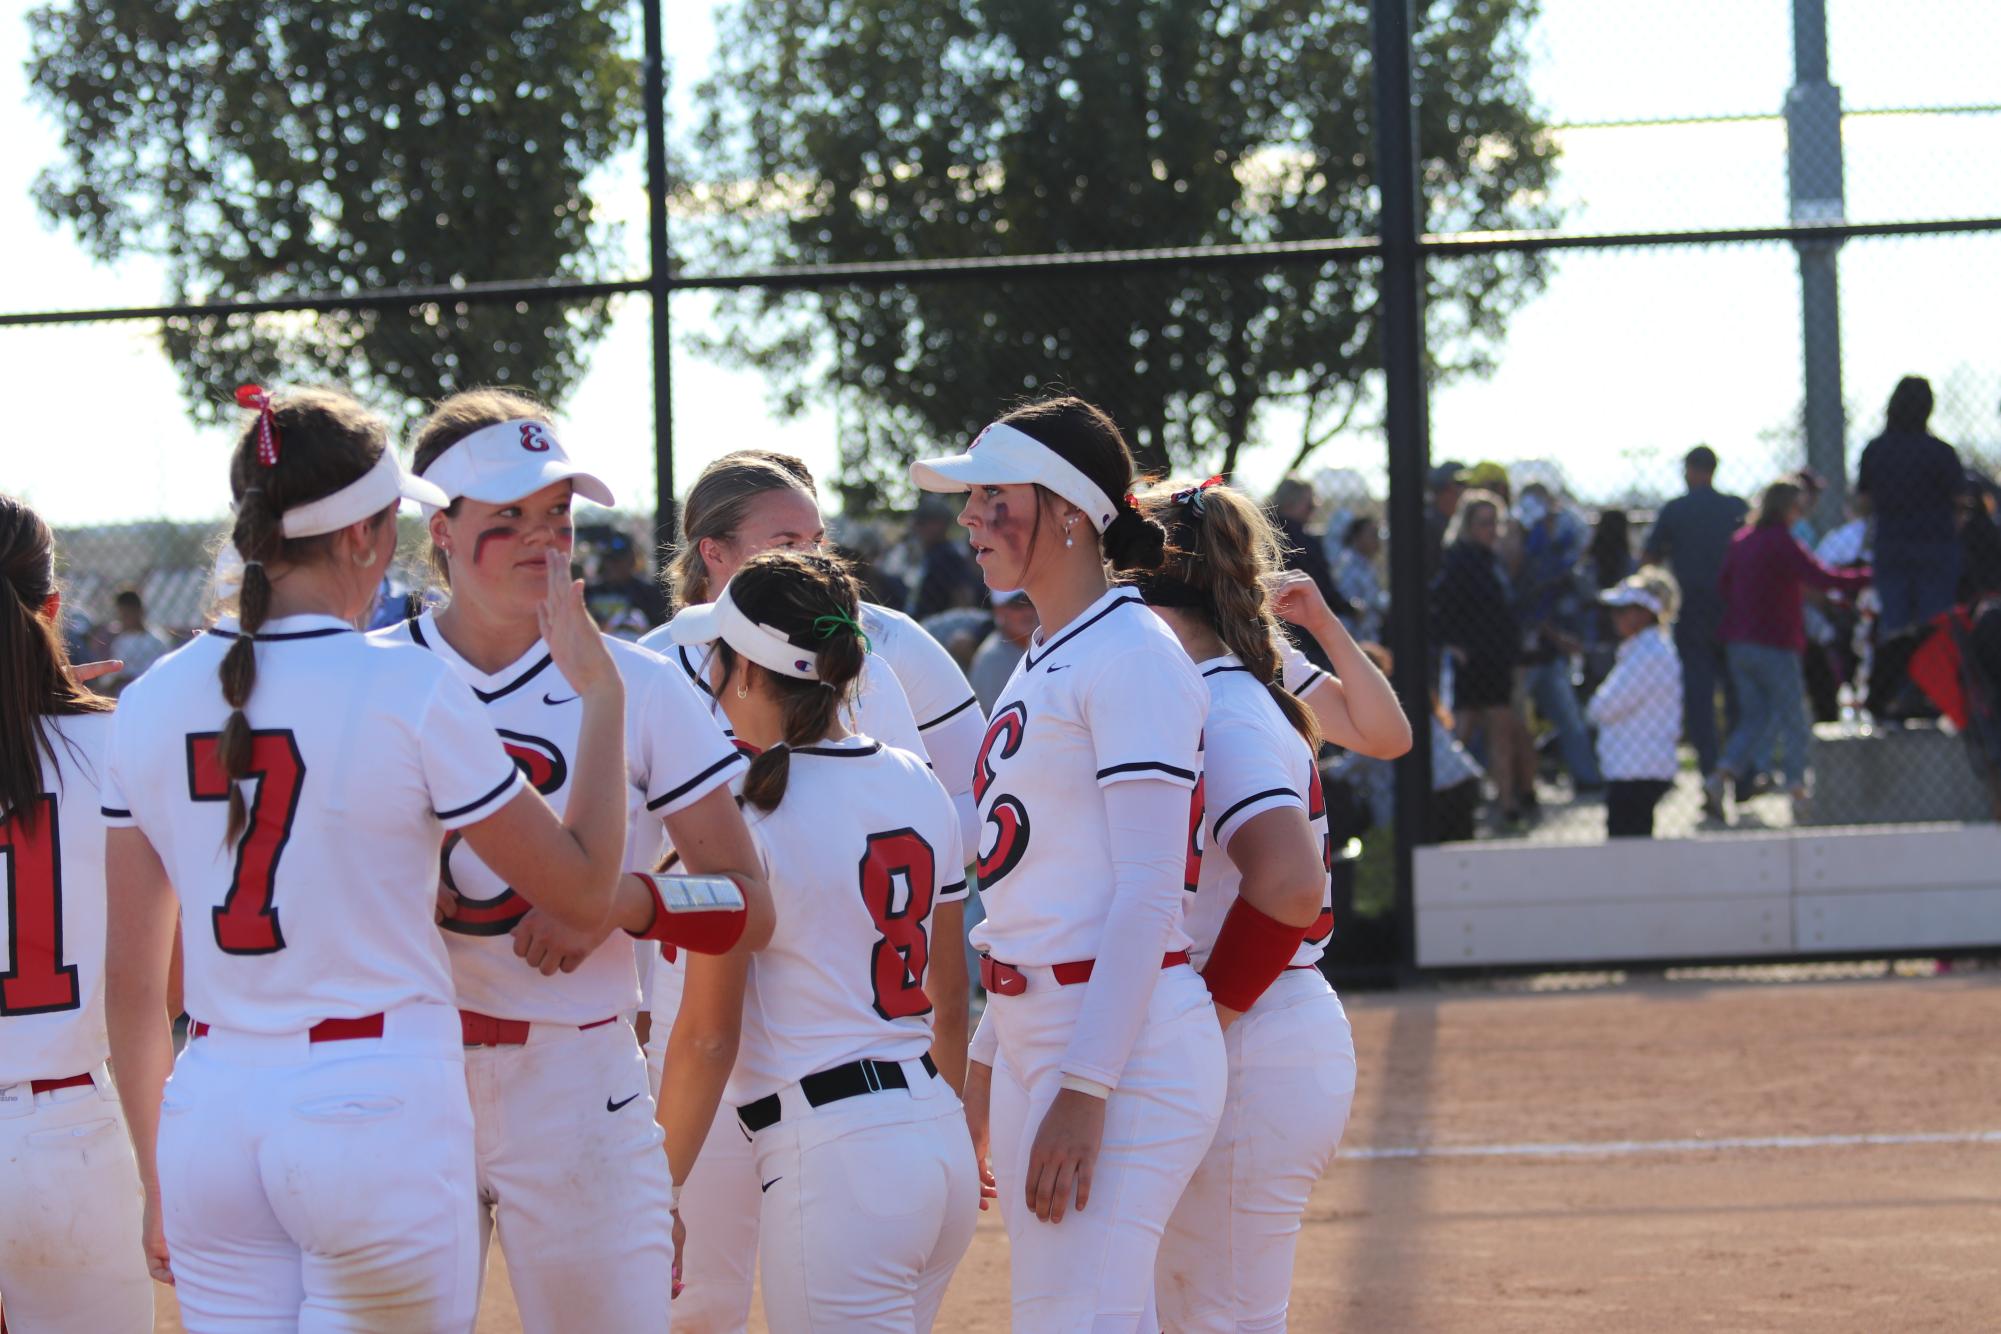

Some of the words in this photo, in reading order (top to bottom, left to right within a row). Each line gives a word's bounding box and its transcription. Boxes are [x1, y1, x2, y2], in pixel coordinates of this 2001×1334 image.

[519, 422, 550, 452] E
[0, 793, 80, 1016] 1
[186, 729, 307, 955] 7
[859, 826, 935, 1021] 8
